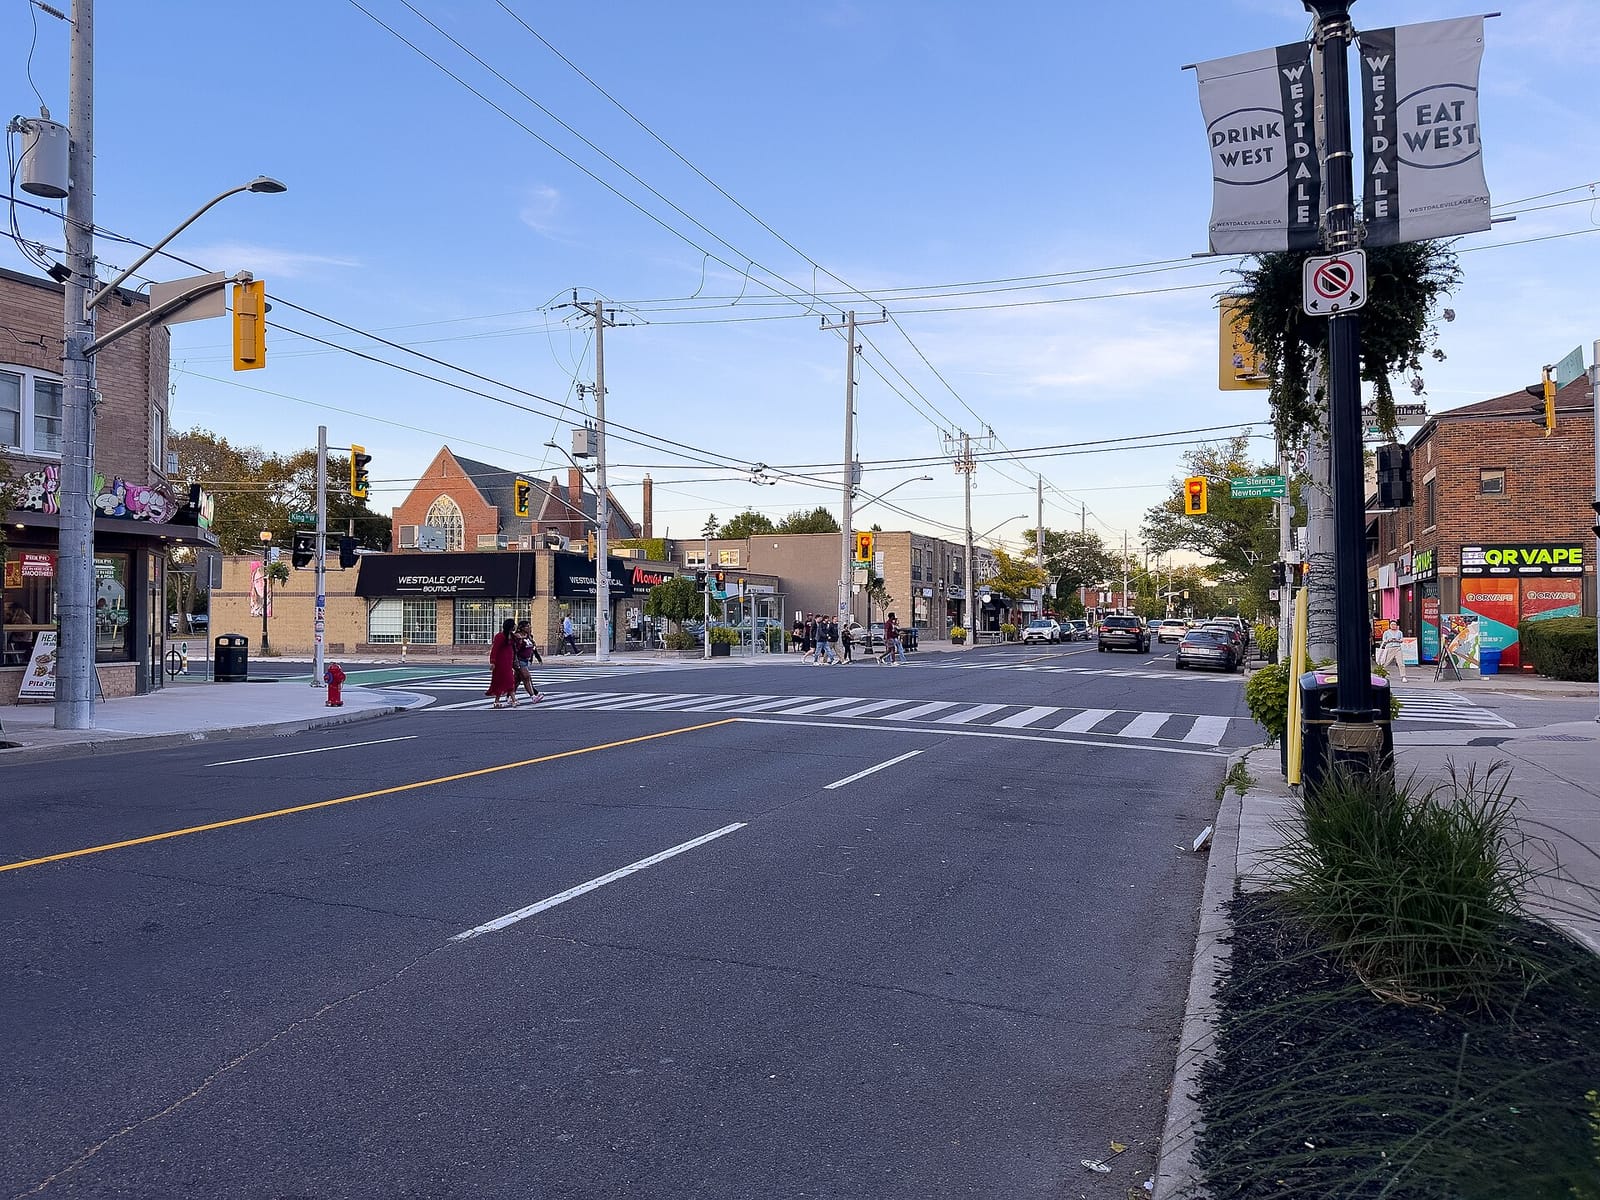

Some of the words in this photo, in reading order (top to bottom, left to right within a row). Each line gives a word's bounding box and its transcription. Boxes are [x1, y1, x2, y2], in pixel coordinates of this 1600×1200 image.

[1416, 100, 1466, 126] EAT
[1211, 121, 1281, 148] DRINK
[1366, 55, 1390, 218] WESTDALE
[1402, 123, 1477, 153] WEST
[1282, 65, 1312, 223] WESTDALE
[1219, 147, 1274, 168] WEST
[1396, 407, 1423, 416] illage
[1246, 478, 1276, 486] Sterling
[1232, 489, 1262, 497] Newton
[291, 513, 305, 523] King
[1520, 548, 1583, 565] VAPE
[398, 576, 445, 584] WESTDALE
[446, 576, 486, 584] OPTICAL
[569, 576, 598, 584] WESTDAL
